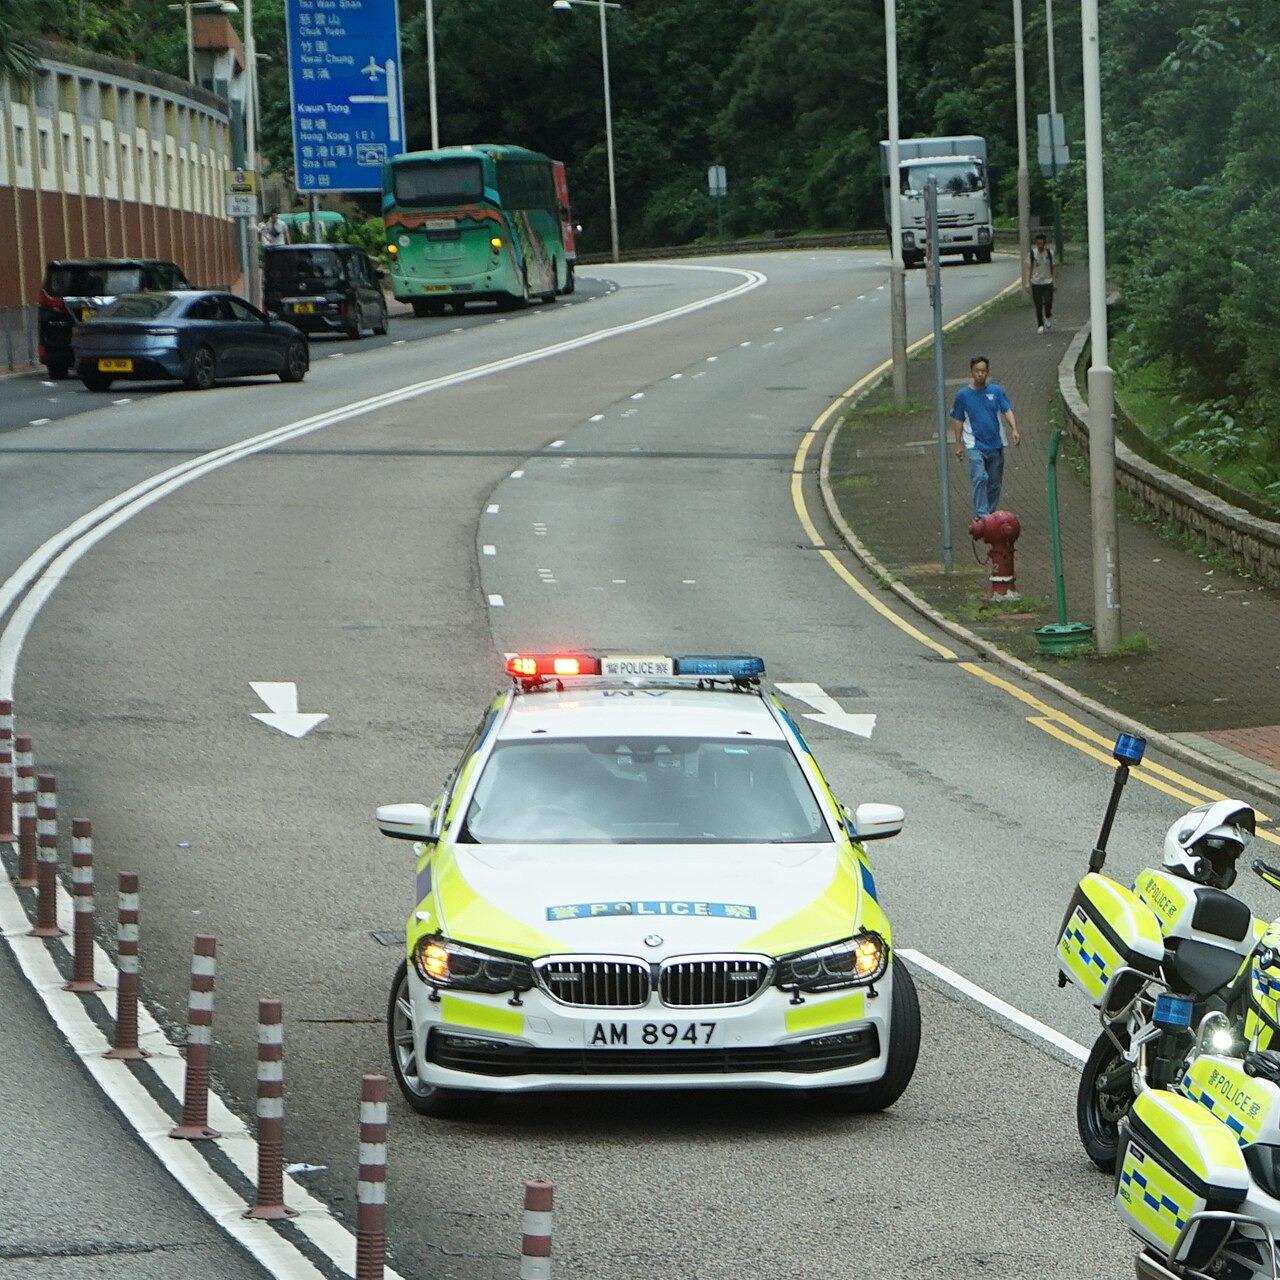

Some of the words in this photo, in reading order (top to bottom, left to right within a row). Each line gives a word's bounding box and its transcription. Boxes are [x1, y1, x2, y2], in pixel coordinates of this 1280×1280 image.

[297, 103, 324, 113] Kwun
[325, 103, 350, 115] Tong
[300, 132, 323, 142] Hong
[326, 131, 351, 143] Kong
[620, 662, 654, 674] POLICE
[1148, 883, 1172, 912] POLICE
[590, 903, 710, 916] POLICE
[591, 1022, 628, 1045] AM
[641, 1022, 717, 1045] 8947
[1215, 1075, 1252, 1112] POLICE
